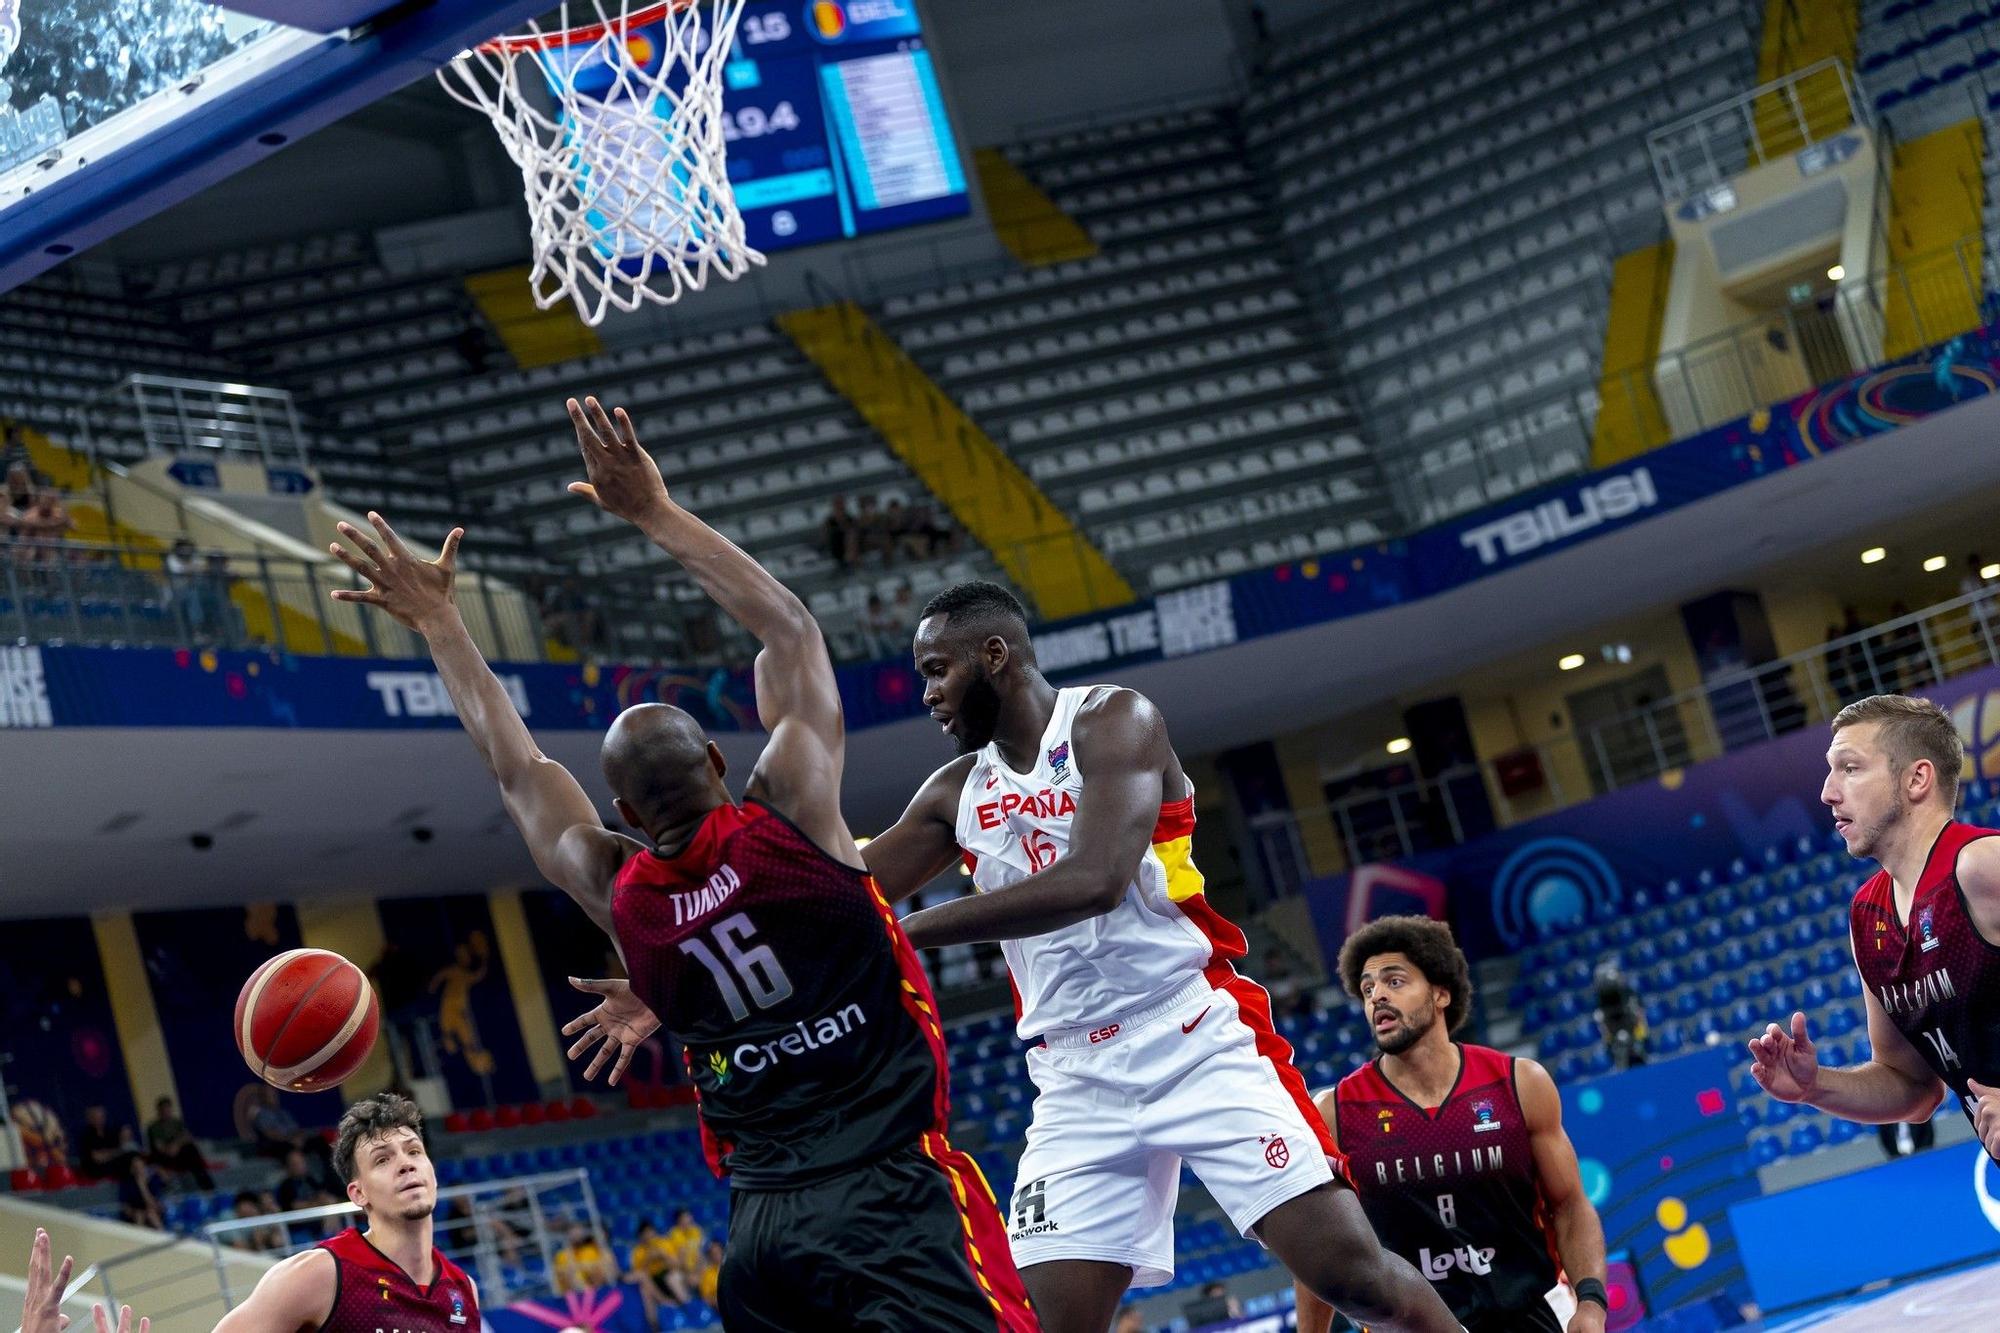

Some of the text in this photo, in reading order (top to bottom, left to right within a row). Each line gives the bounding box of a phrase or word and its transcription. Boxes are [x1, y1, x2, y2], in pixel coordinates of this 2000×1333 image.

[743, 12, 791, 45] 15
[1460, 466, 1658, 565] TBILISI
[1020, 828, 1057, 875] 16
[669, 863, 741, 926] TUMBA
[678, 912, 793, 1022] 16
[733, 1002, 867, 1073] Crelan
[1088, 1022, 1121, 1045] ESP
[1921, 1027, 1962, 1072] 14
[1375, 1145, 1503, 1185] BELGIUM
[1436, 1193, 1458, 1230] 8
[1419, 1244, 1496, 1281] Lotto
